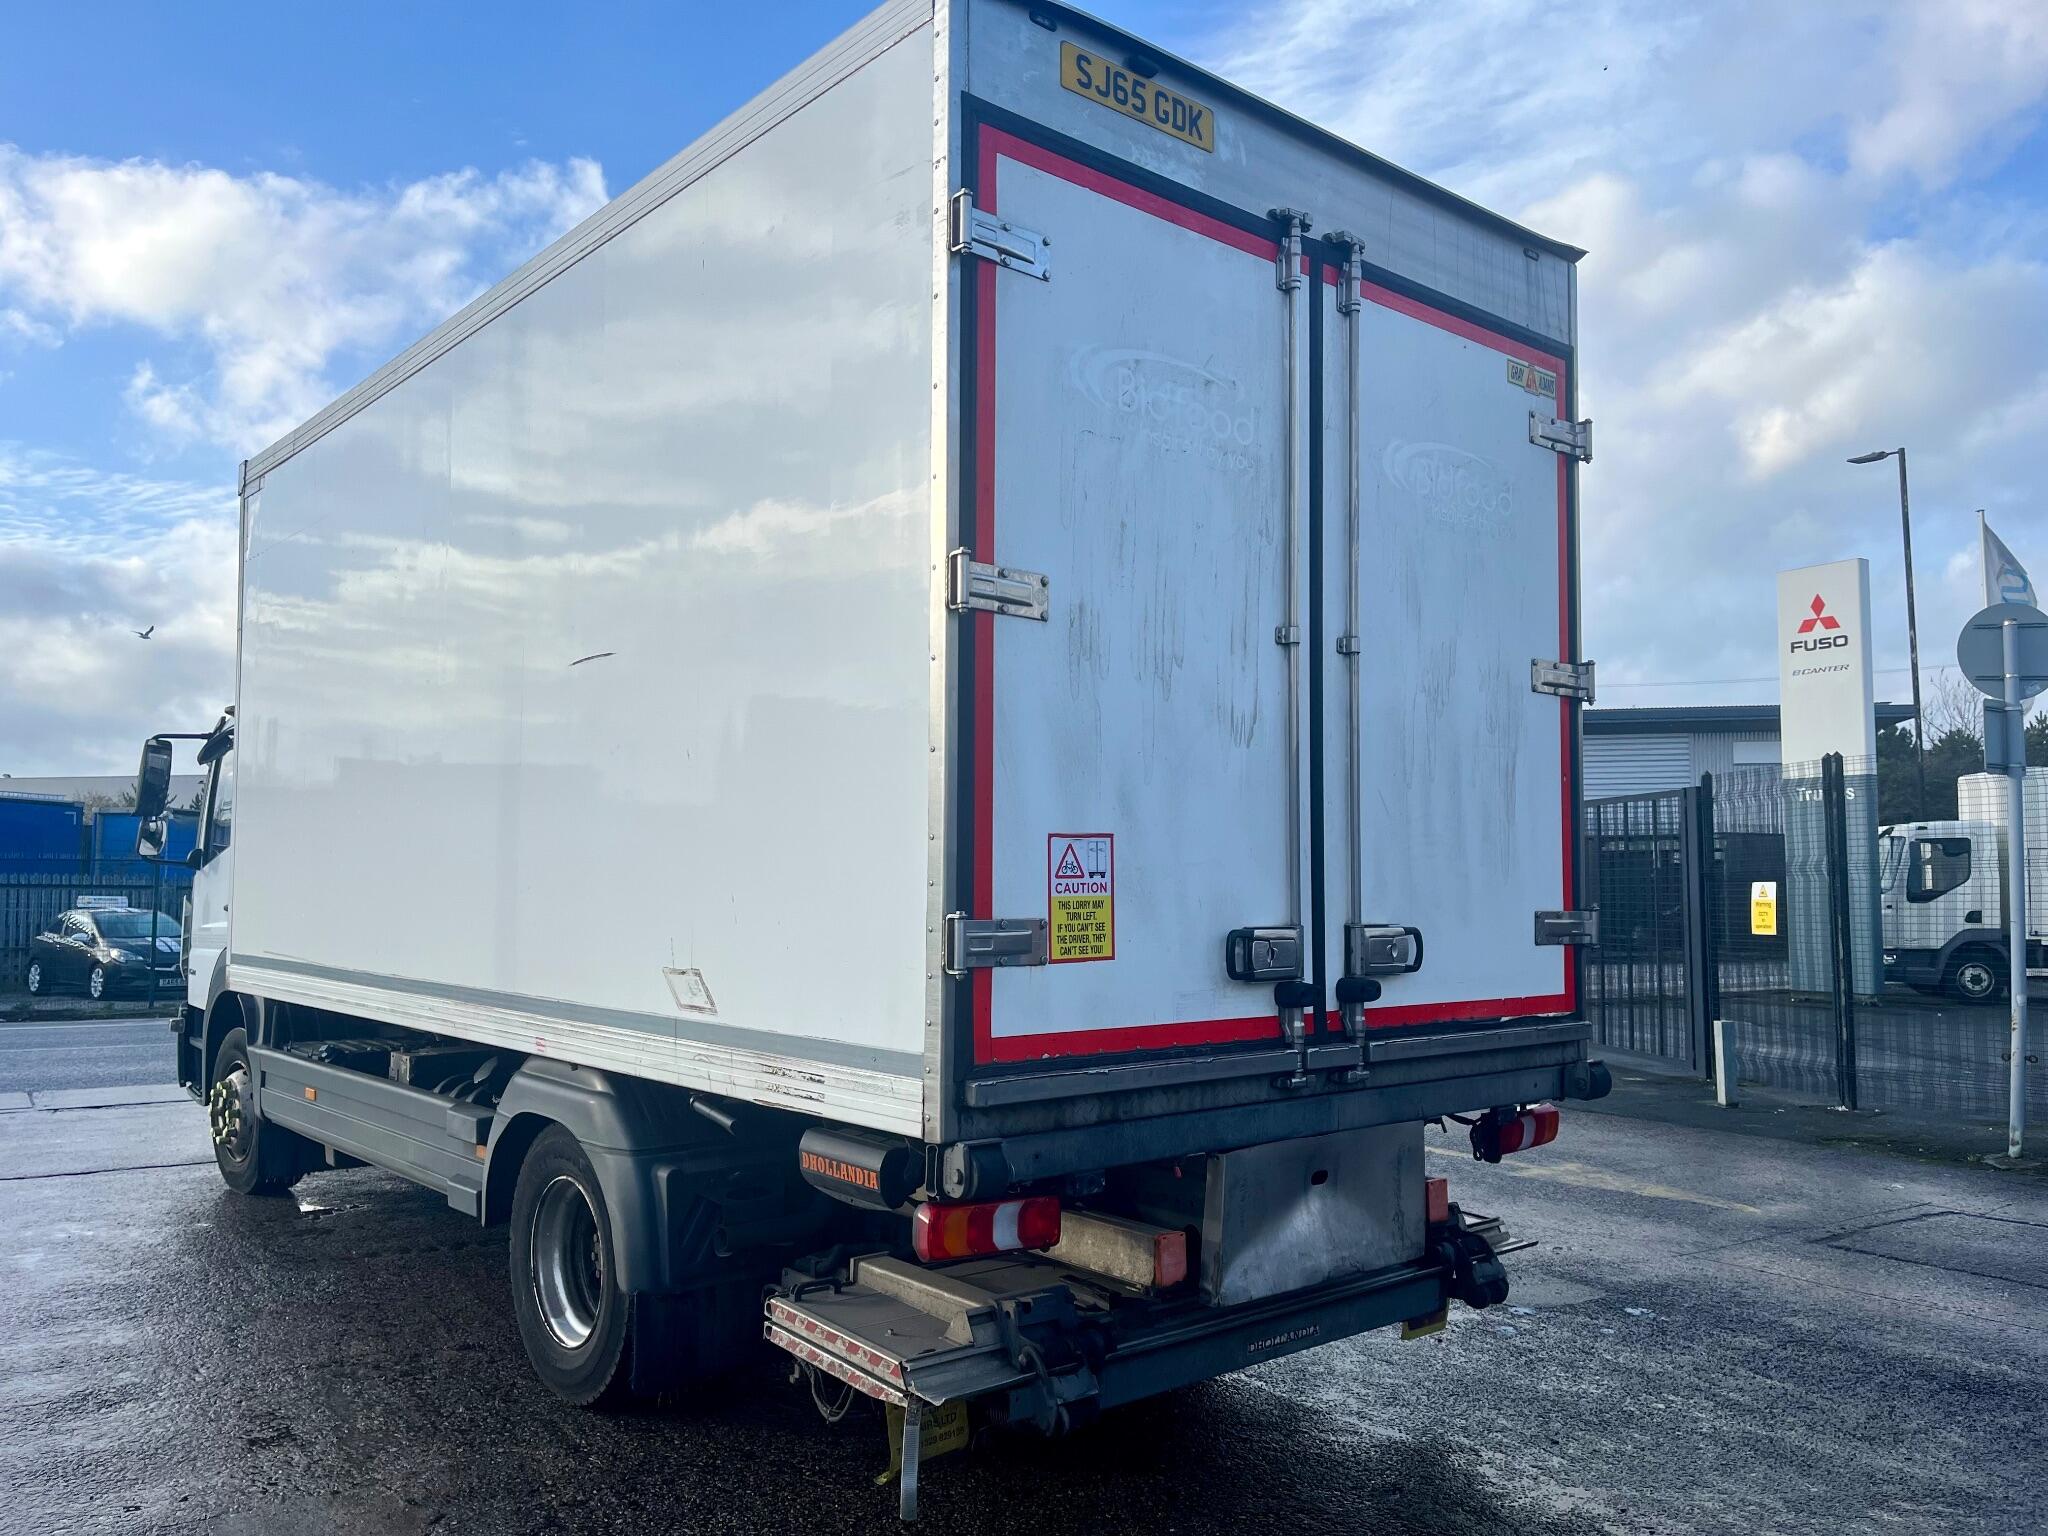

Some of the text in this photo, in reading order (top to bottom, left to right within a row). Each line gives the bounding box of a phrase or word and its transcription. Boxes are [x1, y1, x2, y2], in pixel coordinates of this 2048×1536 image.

[1075, 53, 1203, 142] SJ65 GDK
[1790, 634, 1849, 654] FUSO
[1796, 787, 1855, 801] Trus
[1055, 882, 1108, 894] CAUTION
[1058, 900, 1104, 910] THIS LORRY MAY
[1066, 911, 1097, 921] TURN LEFT.
[1057, 922, 1106, 933] IF YOU CAN'T SEE
[1056, 933, 1106, 944] THE DRIVER, THEY
[1060, 945, 1104, 956] CAN'T SEE YOU!
[802, 1151, 879, 1189] DHOLLANDIA
